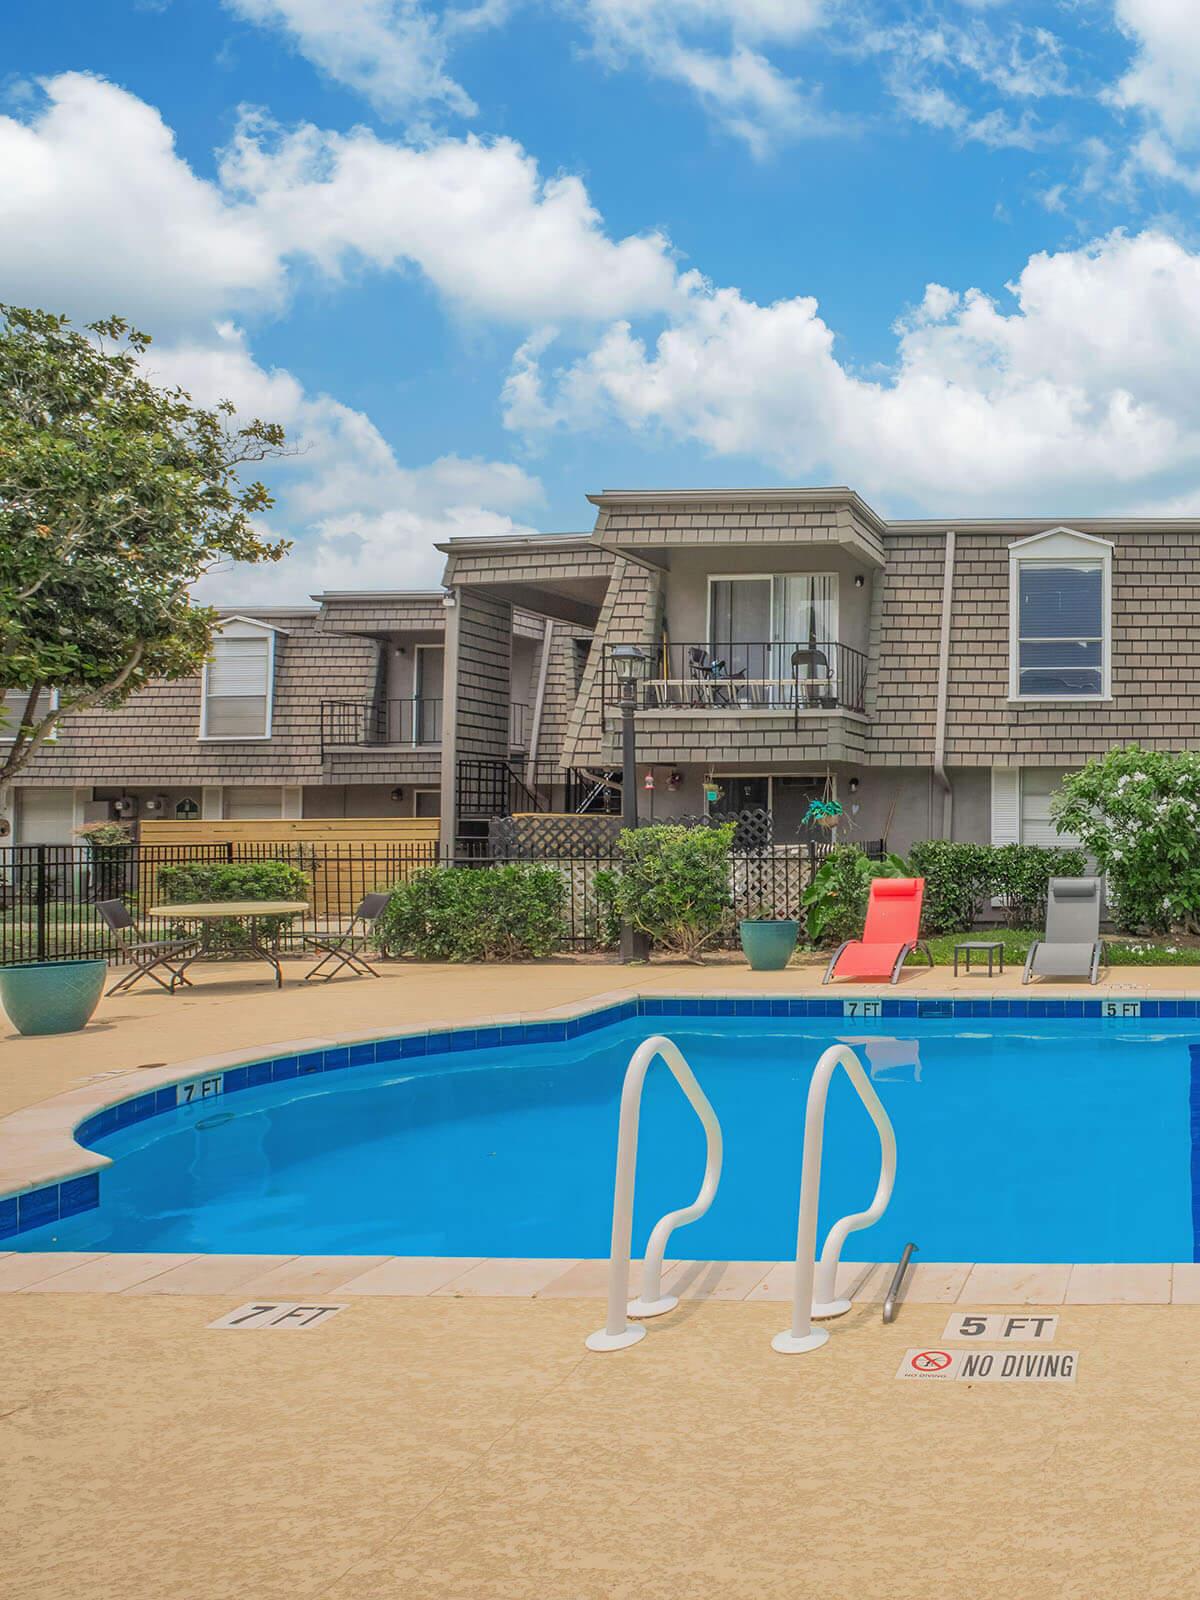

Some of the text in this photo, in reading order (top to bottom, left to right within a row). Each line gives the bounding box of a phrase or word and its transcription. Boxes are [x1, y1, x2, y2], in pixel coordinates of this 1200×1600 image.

[849, 1002, 880, 1017] 7 FT
[1107, 1003, 1139, 1017] 5 FT
[184, 1076, 222, 1102] 7 FT
[229, 1305, 340, 1326] 7 FT
[959, 1317, 1053, 1338] 5 FT
[961, 1355, 1074, 1378] NO DIVING
